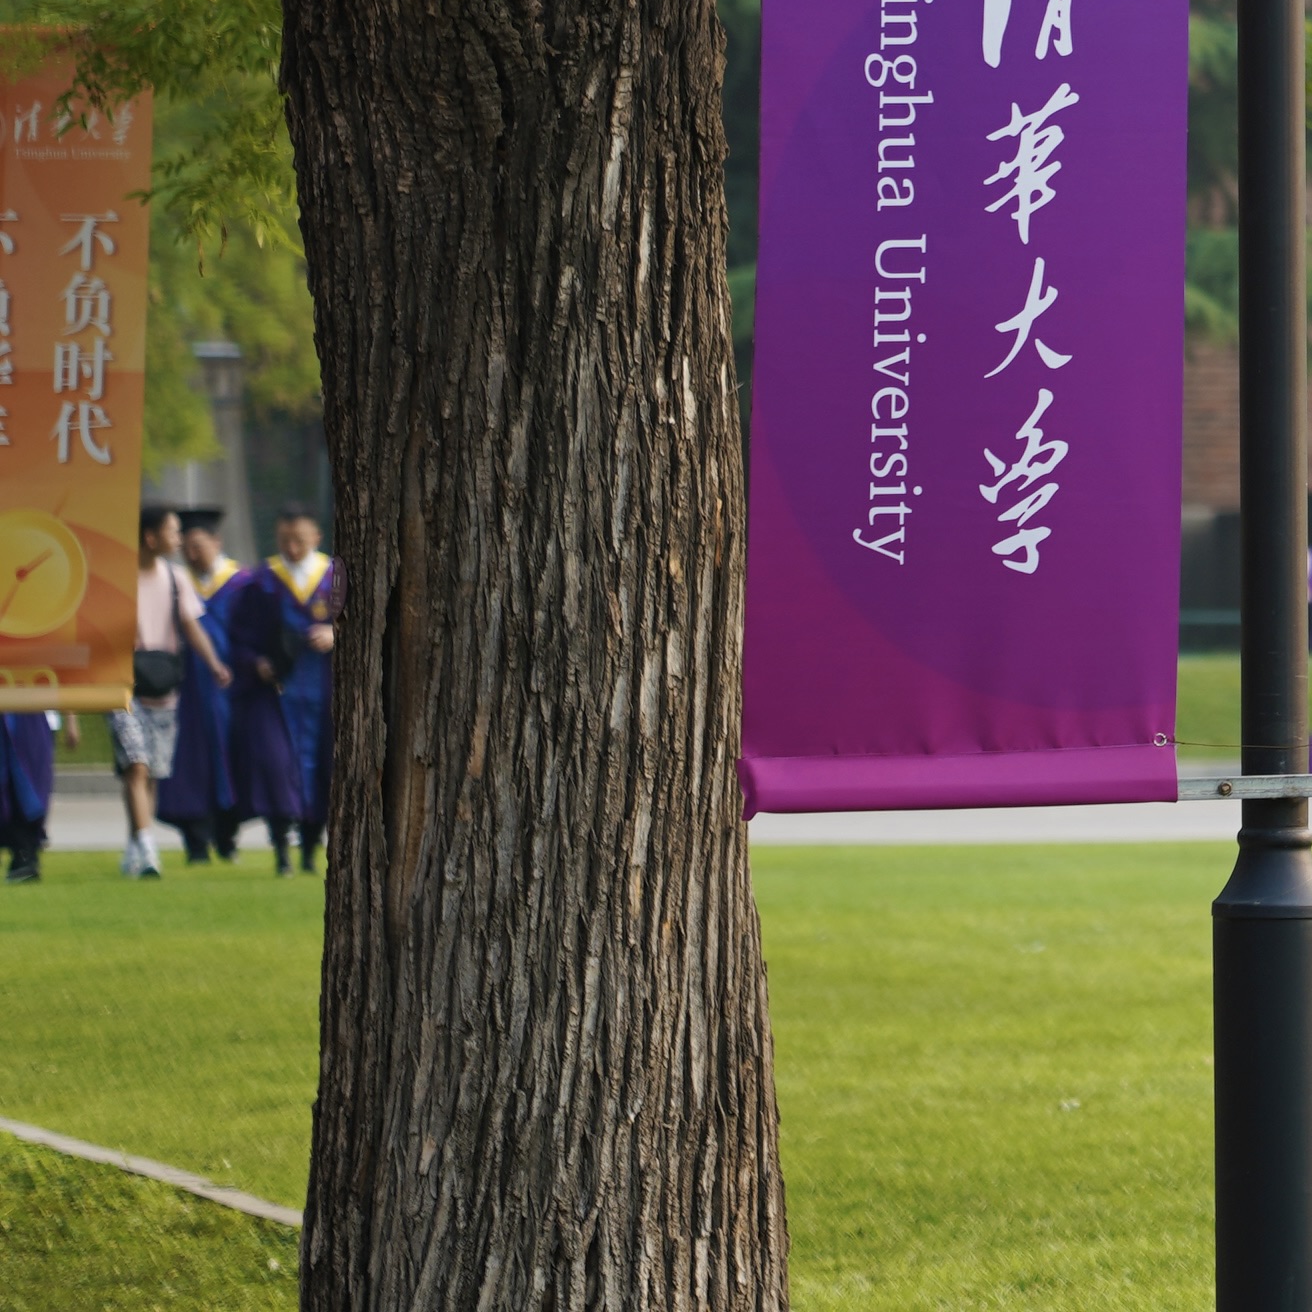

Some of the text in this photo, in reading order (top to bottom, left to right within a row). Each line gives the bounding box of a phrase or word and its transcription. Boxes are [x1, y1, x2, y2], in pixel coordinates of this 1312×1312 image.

[50, 208, 119, 465] 不负时代
[852, 233, 927, 565] University
